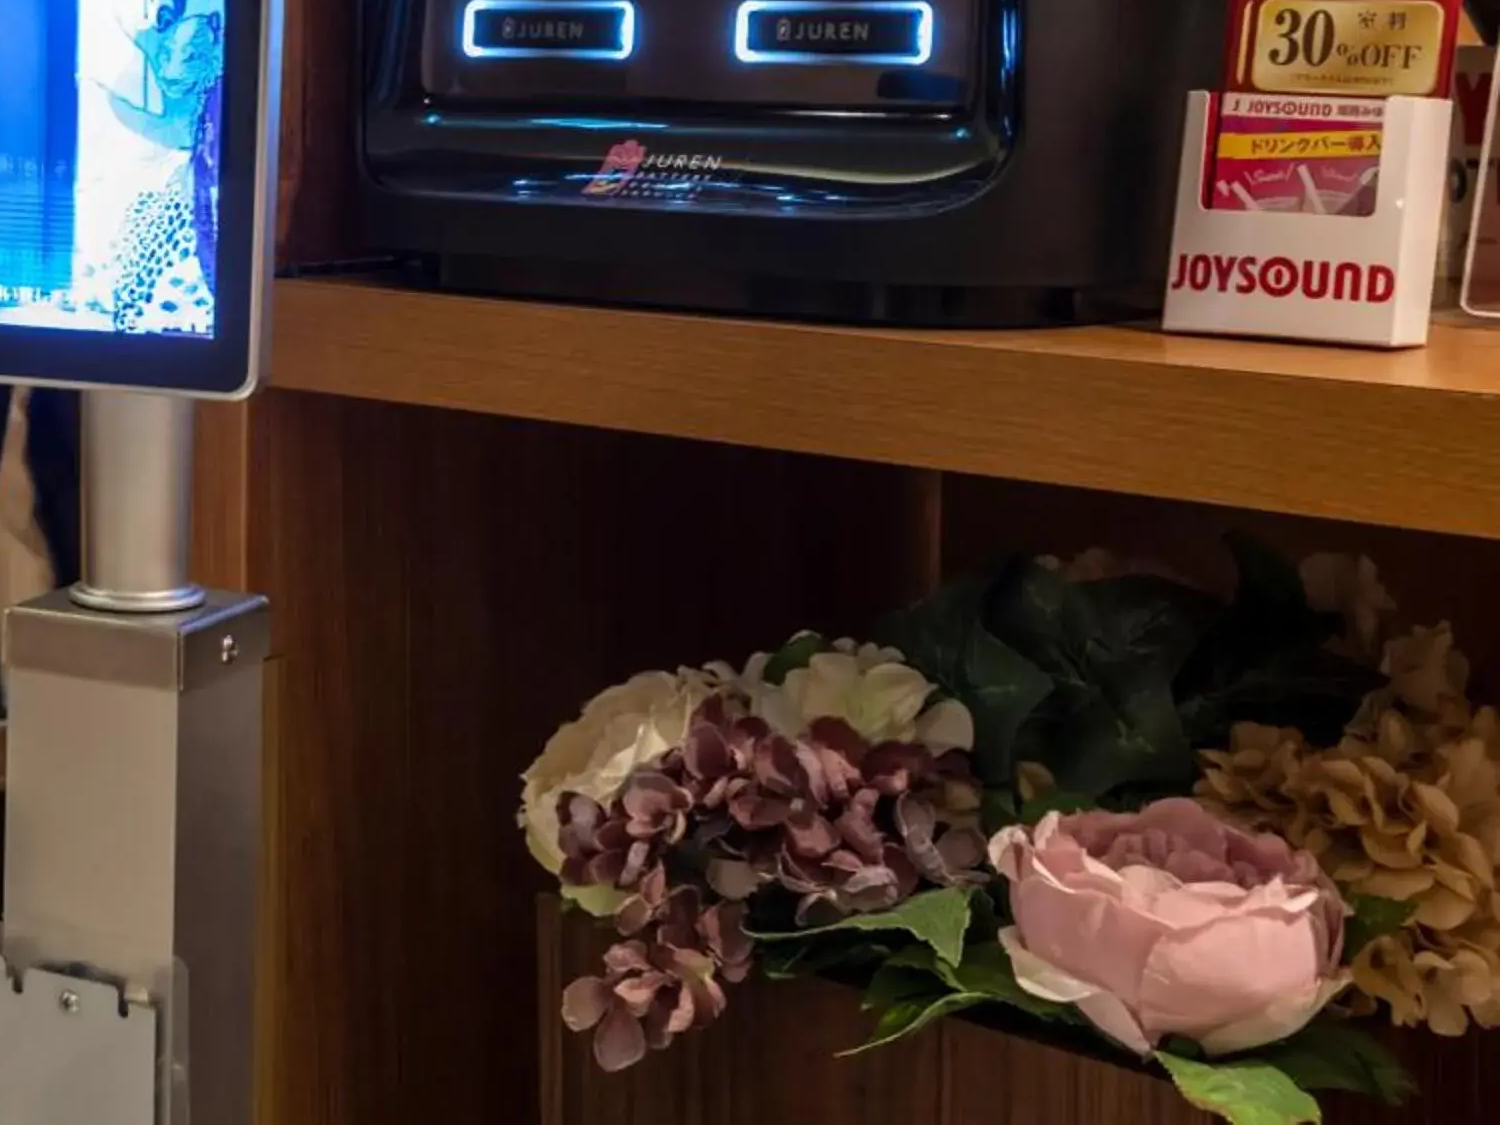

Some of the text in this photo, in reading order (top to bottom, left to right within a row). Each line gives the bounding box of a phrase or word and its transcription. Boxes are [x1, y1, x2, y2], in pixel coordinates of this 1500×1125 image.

[519, 21, 584, 40] JUREN
[795, 21, 870, 42] JUREN
[1251, 134, 1382, 154] ドリンクバー導入
[642, 154, 722, 170] JUREN
[1171, 254, 1394, 303] JOYSOUND
